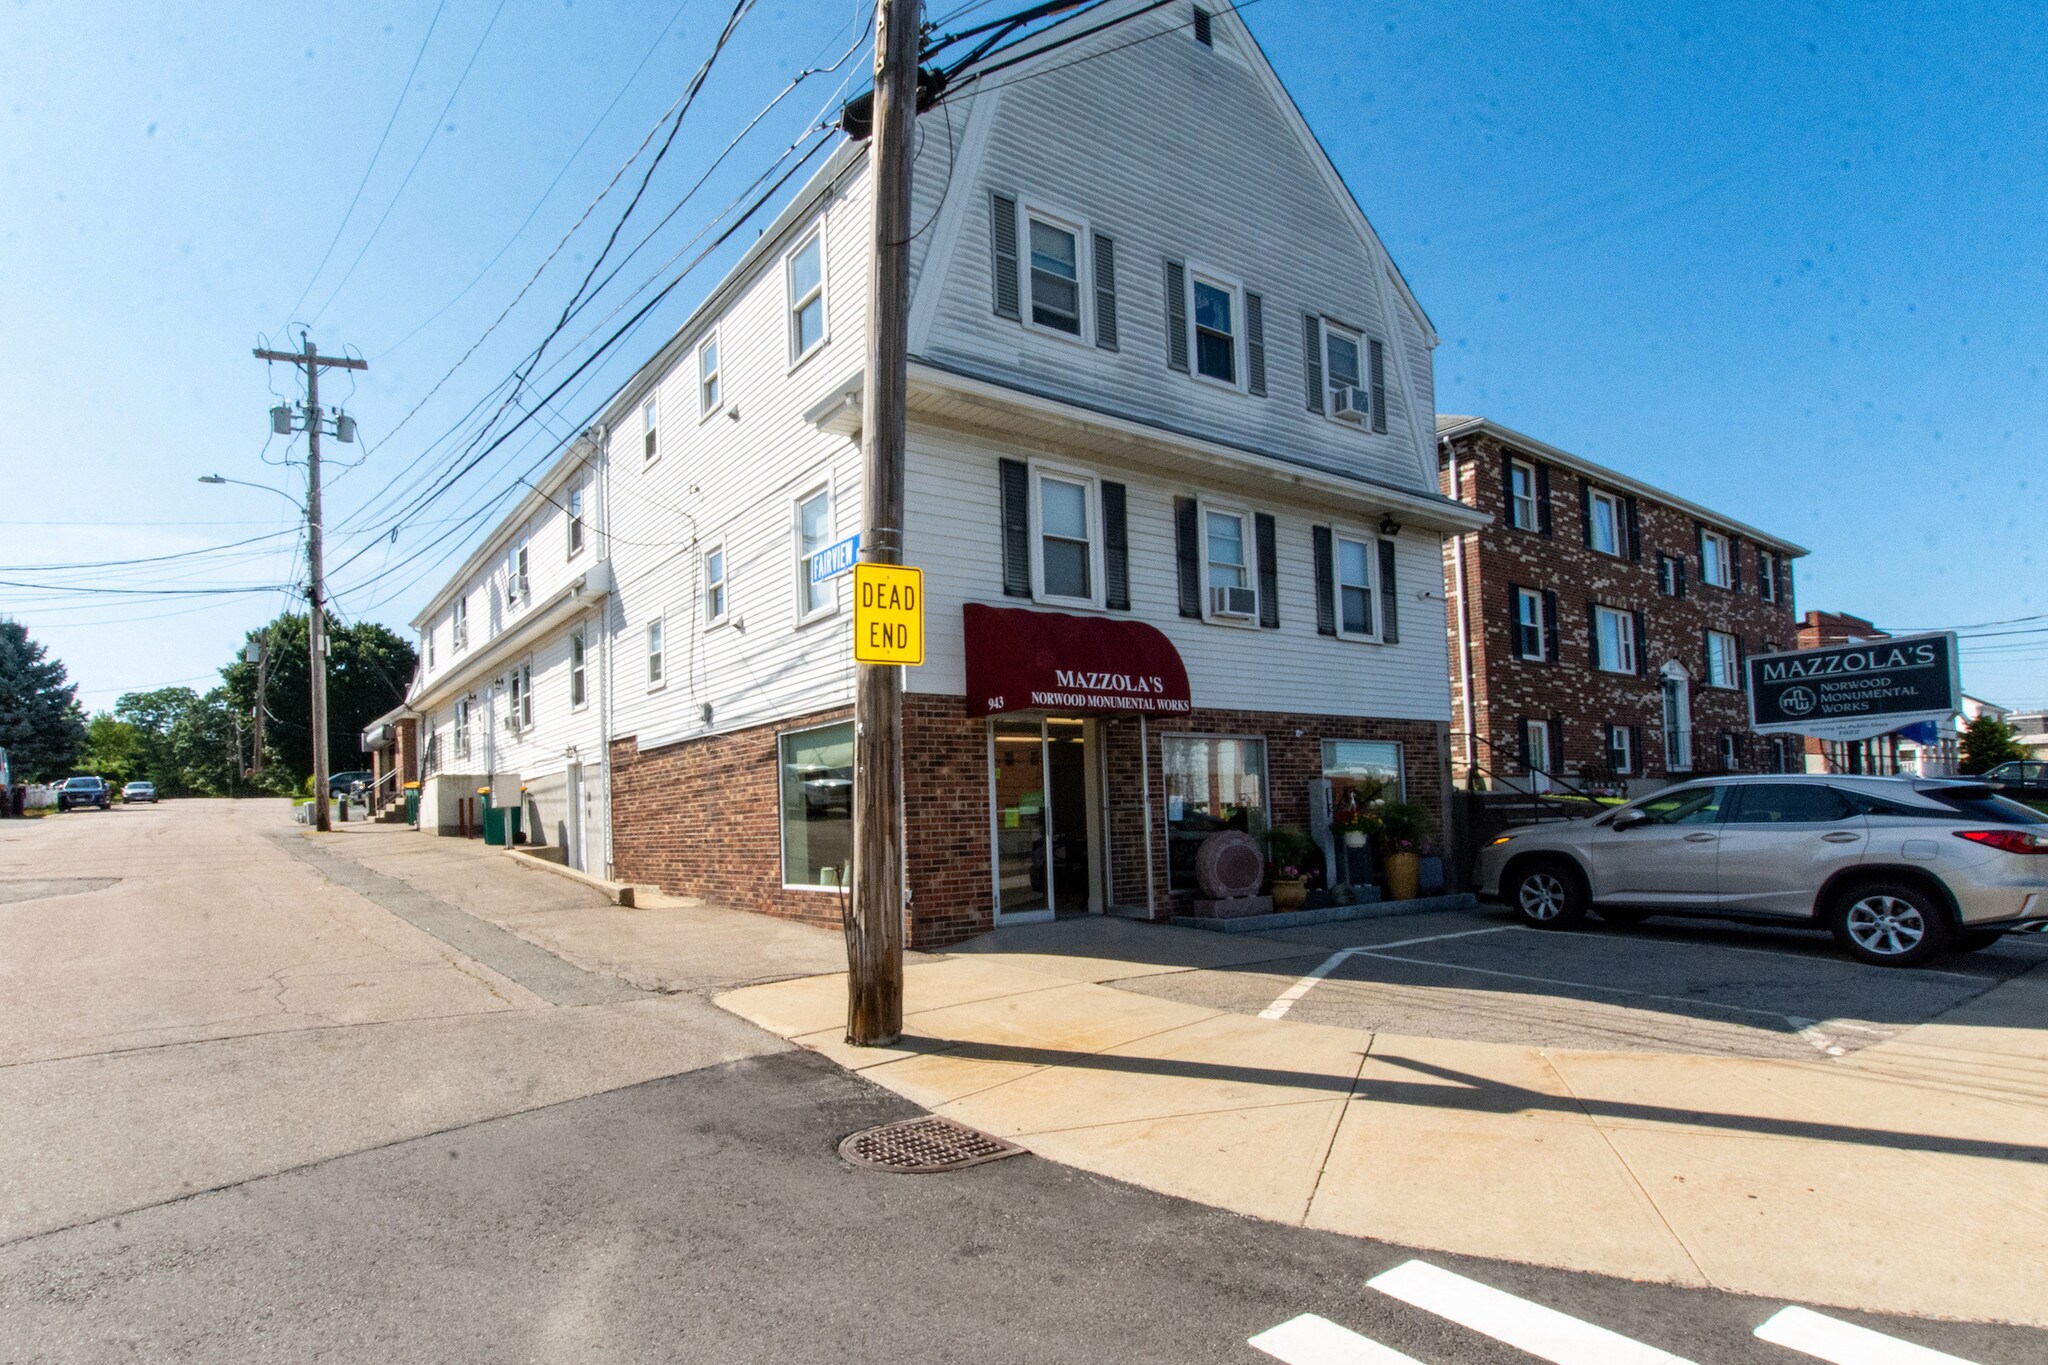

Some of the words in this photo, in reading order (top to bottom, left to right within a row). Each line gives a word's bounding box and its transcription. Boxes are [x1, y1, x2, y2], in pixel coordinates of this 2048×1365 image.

[813, 538, 854, 581] FAIRVIEW
[862, 582, 915, 611] DEAD
[870, 621, 908, 649] END
[1763, 644, 1936, 681] MAZZOLA'S
[1054, 669, 1164, 694] MAZZOLA'S
[1820, 677, 1892, 693] NORWOOD
[988, 695, 1004, 711] 943
[1031, 691, 1086, 707] NORWOOD
[1087, 694, 1156, 710] MONUMENTAL
[1156, 698, 1190, 712] WORKS
[1820, 686, 1920, 704] MONUMENTAL
[1820, 701, 1870, 714] WORKS
